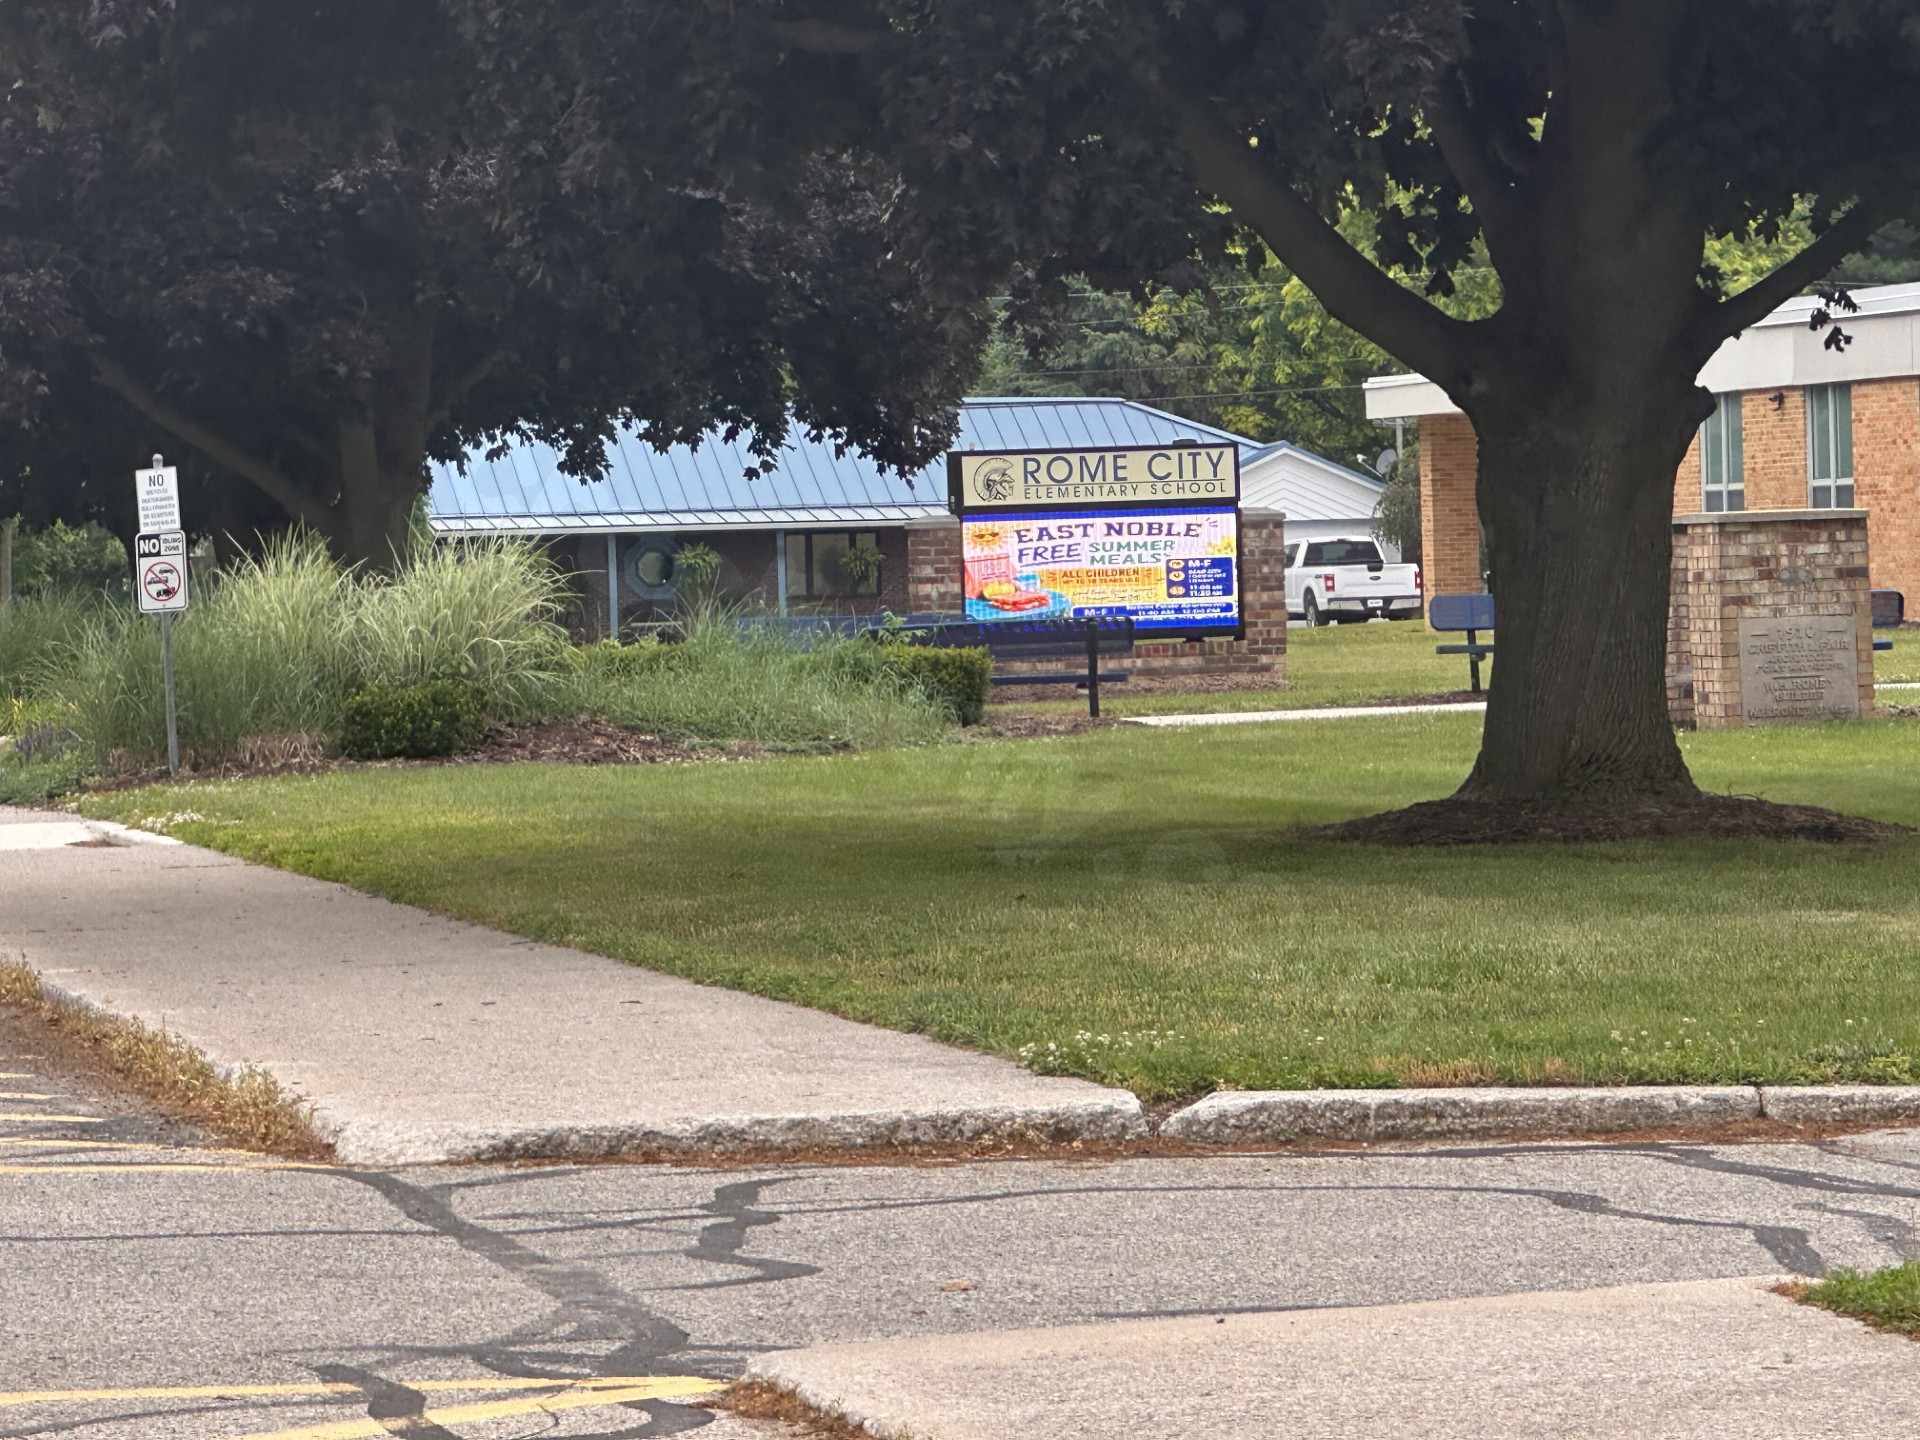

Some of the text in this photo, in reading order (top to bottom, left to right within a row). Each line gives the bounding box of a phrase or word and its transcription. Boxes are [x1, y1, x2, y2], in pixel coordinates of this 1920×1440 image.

[1023, 451, 1225, 484] ROME CITY
[148, 474, 164, 487] NO
[1024, 481, 1226, 499] ELEMENTARY SCHOOL
[1015, 522, 1202, 543] EAST NOBLE
[139, 539, 160, 554] NO
[1017, 540, 1175, 563] FREE SUMMER
[1090, 553, 1162, 565] MEALS
[1062, 567, 1140, 578] ALL CHILDREN
